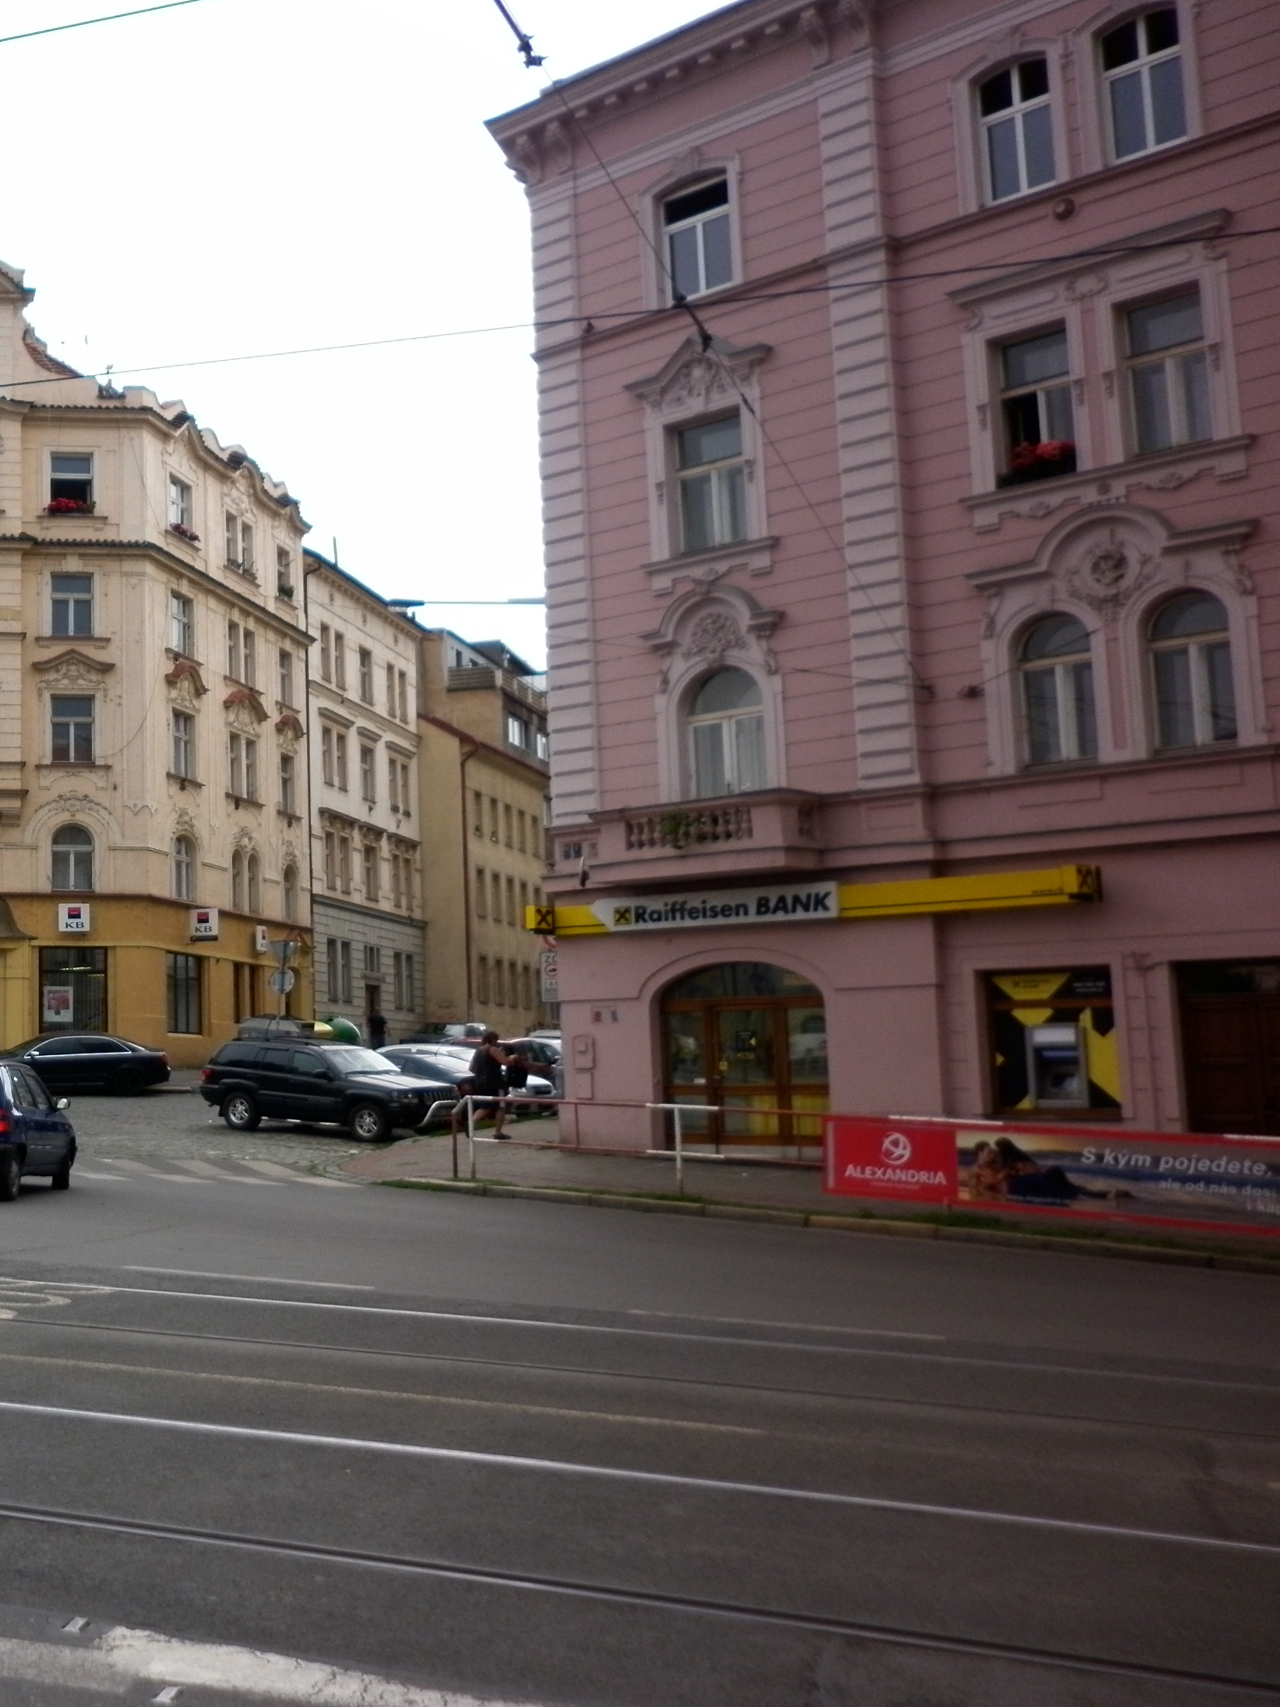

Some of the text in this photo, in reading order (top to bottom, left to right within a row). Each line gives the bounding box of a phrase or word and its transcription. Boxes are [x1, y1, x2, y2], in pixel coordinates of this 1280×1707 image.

[634, 891, 831, 924] Raiffeisen BANK
[65, 921, 84, 929] KB
[194, 925, 213, 933] KB
[1080, 1147, 1273, 1178] S kým pojedete,
[844, 1164, 947, 1185] ALEXANDRIA
[1185, 1180, 1205, 1192] od
